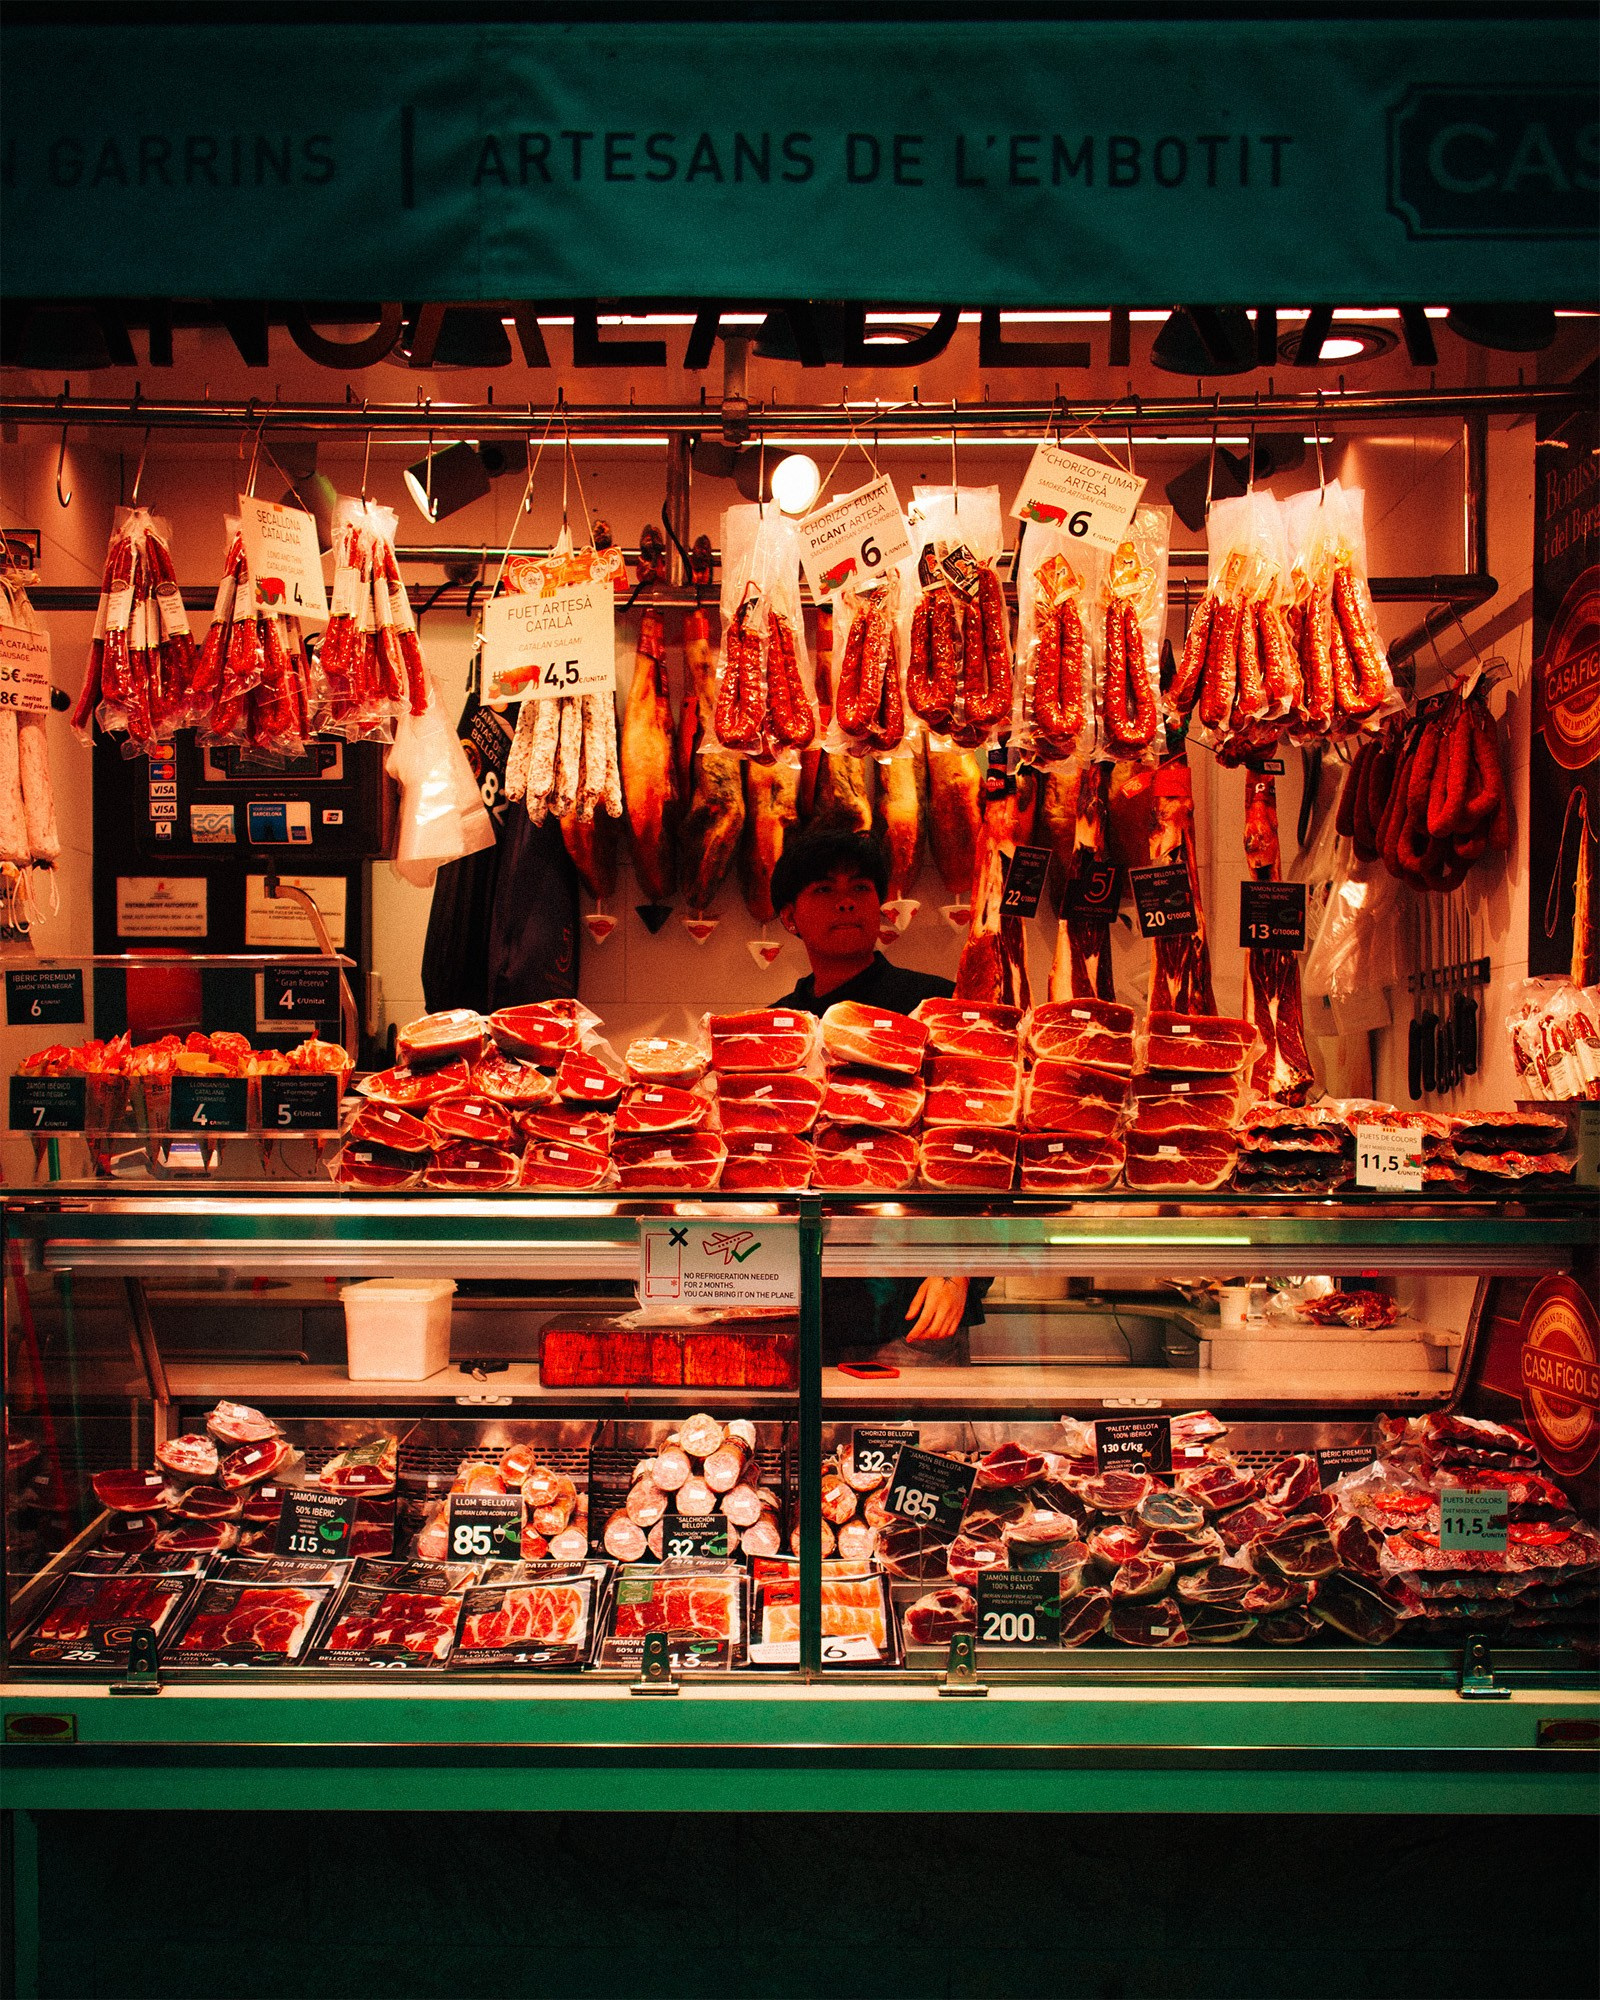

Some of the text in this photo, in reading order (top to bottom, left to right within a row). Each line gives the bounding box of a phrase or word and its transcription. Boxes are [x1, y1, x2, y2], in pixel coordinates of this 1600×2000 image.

[48, 134, 336, 189] GARRINS
[473, 130, 814, 187] ARTESANS
[847, 132, 924, 187] DE
[1102, 472, 1140, 493] FUMAT
[854, 482, 888, 510] FUMAT
[1037, 478, 1126, 514] SMOKED ARTISAN CHORIZO
[256, 509, 301, 531] SECALLONA
[1068, 510, 1093, 538] 6
[261, 526, 301, 545] CATALANA
[810, 523, 847, 549] PICANT
[861, 536, 882, 568] 6
[294, 583, 303, 607] 4
[508, 594, 592, 621] FUET ARTESÀ
[526, 613, 573, 633] CATALÀ
[6, 640, 48, 653] CATALANA
[519, 637, 583, 652] CATALAN SALAMI
[544, 660, 580, 691] 4,5
[1547, 667, 1577, 701] CASA
[153, 786, 175, 795] VISA
[153, 805, 176, 814] VISA
[1005, 889, 1021, 906] 22
[1145, 911, 1166, 928] 20
[1248, 923, 1270, 940] 13
[12, 973, 76, 983] IBÈRIC PREMIUM
[30, 999, 42, 1017] 6
[278, 989, 295, 1010] 4
[32, 1107, 46, 1127] 7
[191, 1103, 208, 1126] 4
[277, 1104, 292, 1125] 5
[1361, 1153, 1399, 1173] 11,5
[696, 1272, 751, 1280] REFRIGERATION
[751, 1273, 779, 1281] NEEDED
[1524, 1353, 1554, 1388] CASA
[1132, 1423, 1159, 1431] BELLOTA
[1102, 1442, 1144, 1454] 130 €/kg
[1342, 1448, 1372, 1457] PREMIUM
[859, 1450, 886, 1472] 32
[918, 1461, 931, 1471] 75%
[295, 1505, 311, 1515] 50%
[455, 1498, 477, 1506] LLOM
[893, 1485, 940, 1522] 185
[1444, 1517, 1484, 1537] 11,5
[288, 1534, 319, 1554] 115
[453, 1525, 491, 1556] 85
[667, 1539, 694, 1558] 32
[983, 1612, 1036, 1643] 200
[61, 1650, 101, 1662] 25
[513, 1652, 542, 1664] 15
[668, 1653, 701, 1668] 13
[823, 1645, 848, 1659] 6
